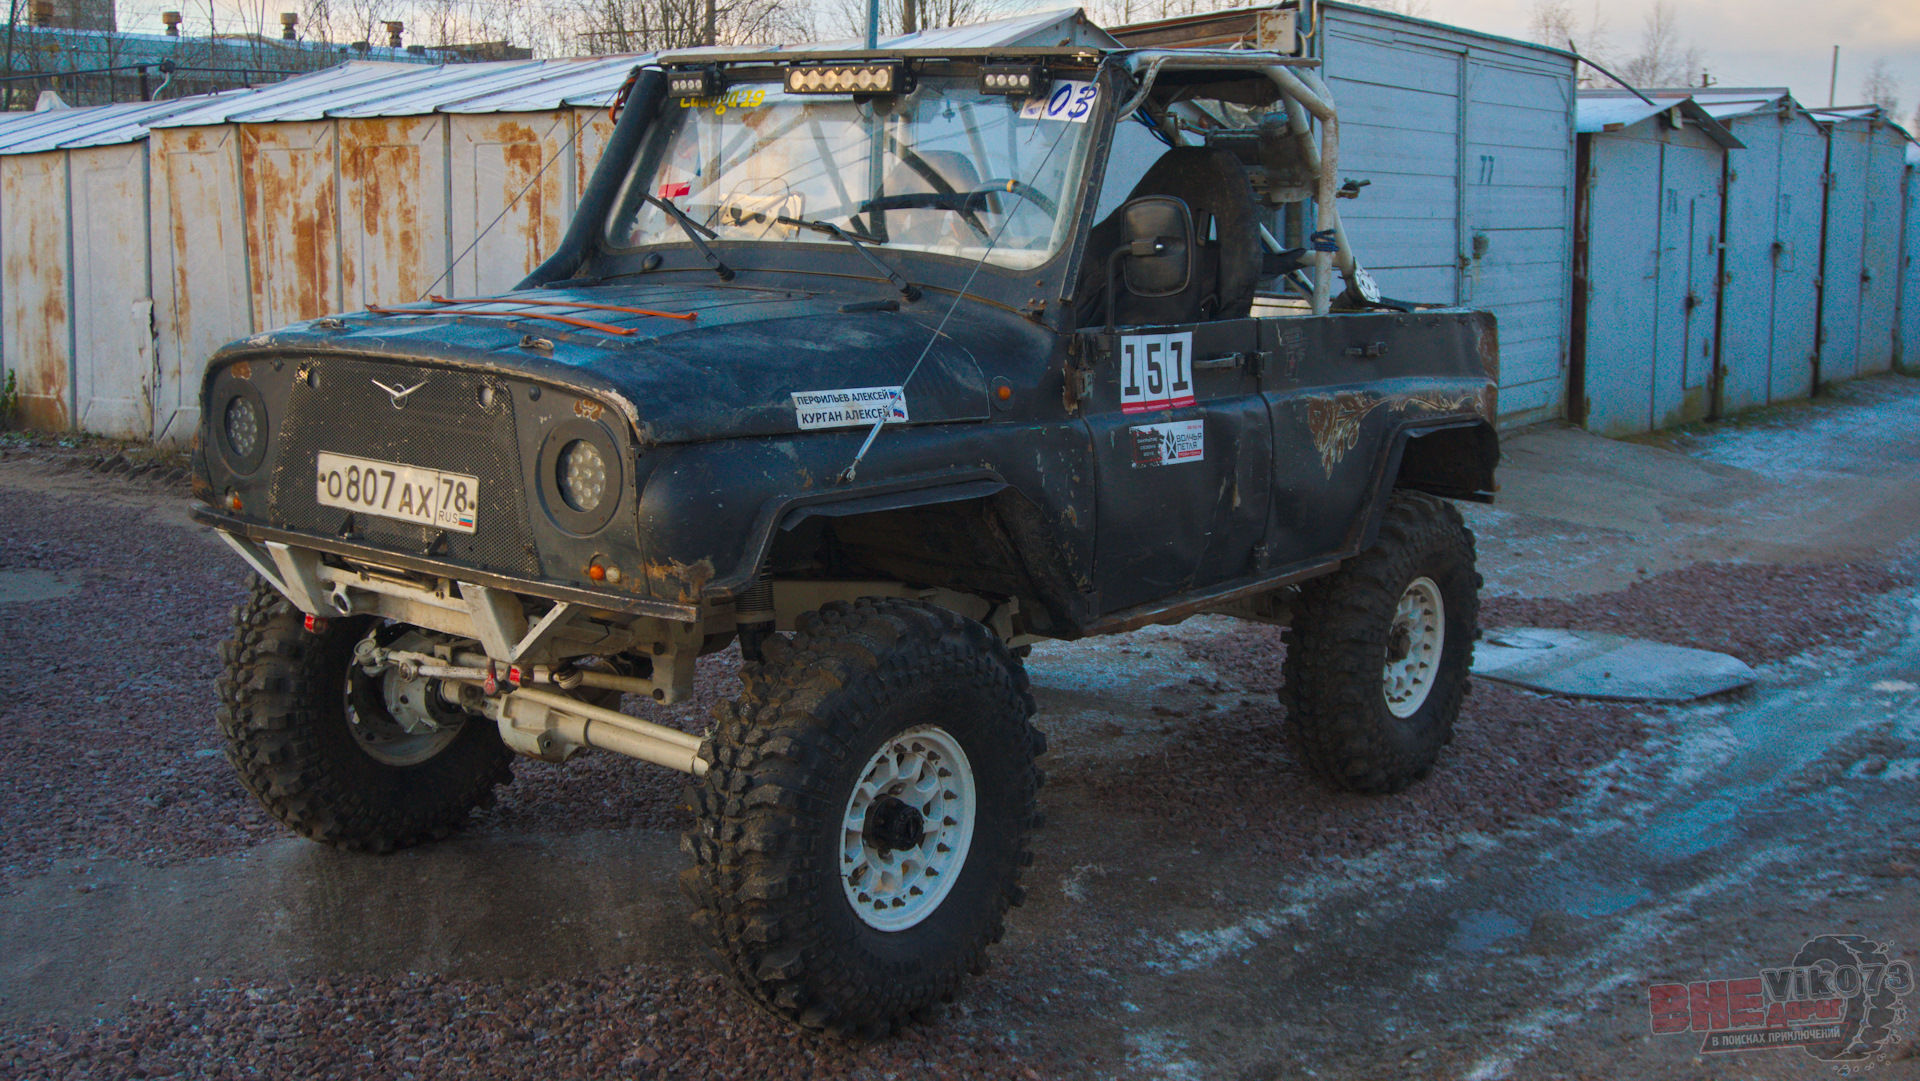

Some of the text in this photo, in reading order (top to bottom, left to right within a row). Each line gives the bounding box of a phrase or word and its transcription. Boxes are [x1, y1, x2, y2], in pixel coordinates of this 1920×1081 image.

[1124, 341, 1189, 397] 151
[796, 389, 890, 405] ПЕРФИЛЬЕВ АЛЕКСЕЙ
[801, 410, 843, 424] КУРГАН
[1177, 441, 1198, 451] ПЕТЛЯ
[442, 478, 468, 513] 78
[438, 510, 459, 524] RUS
